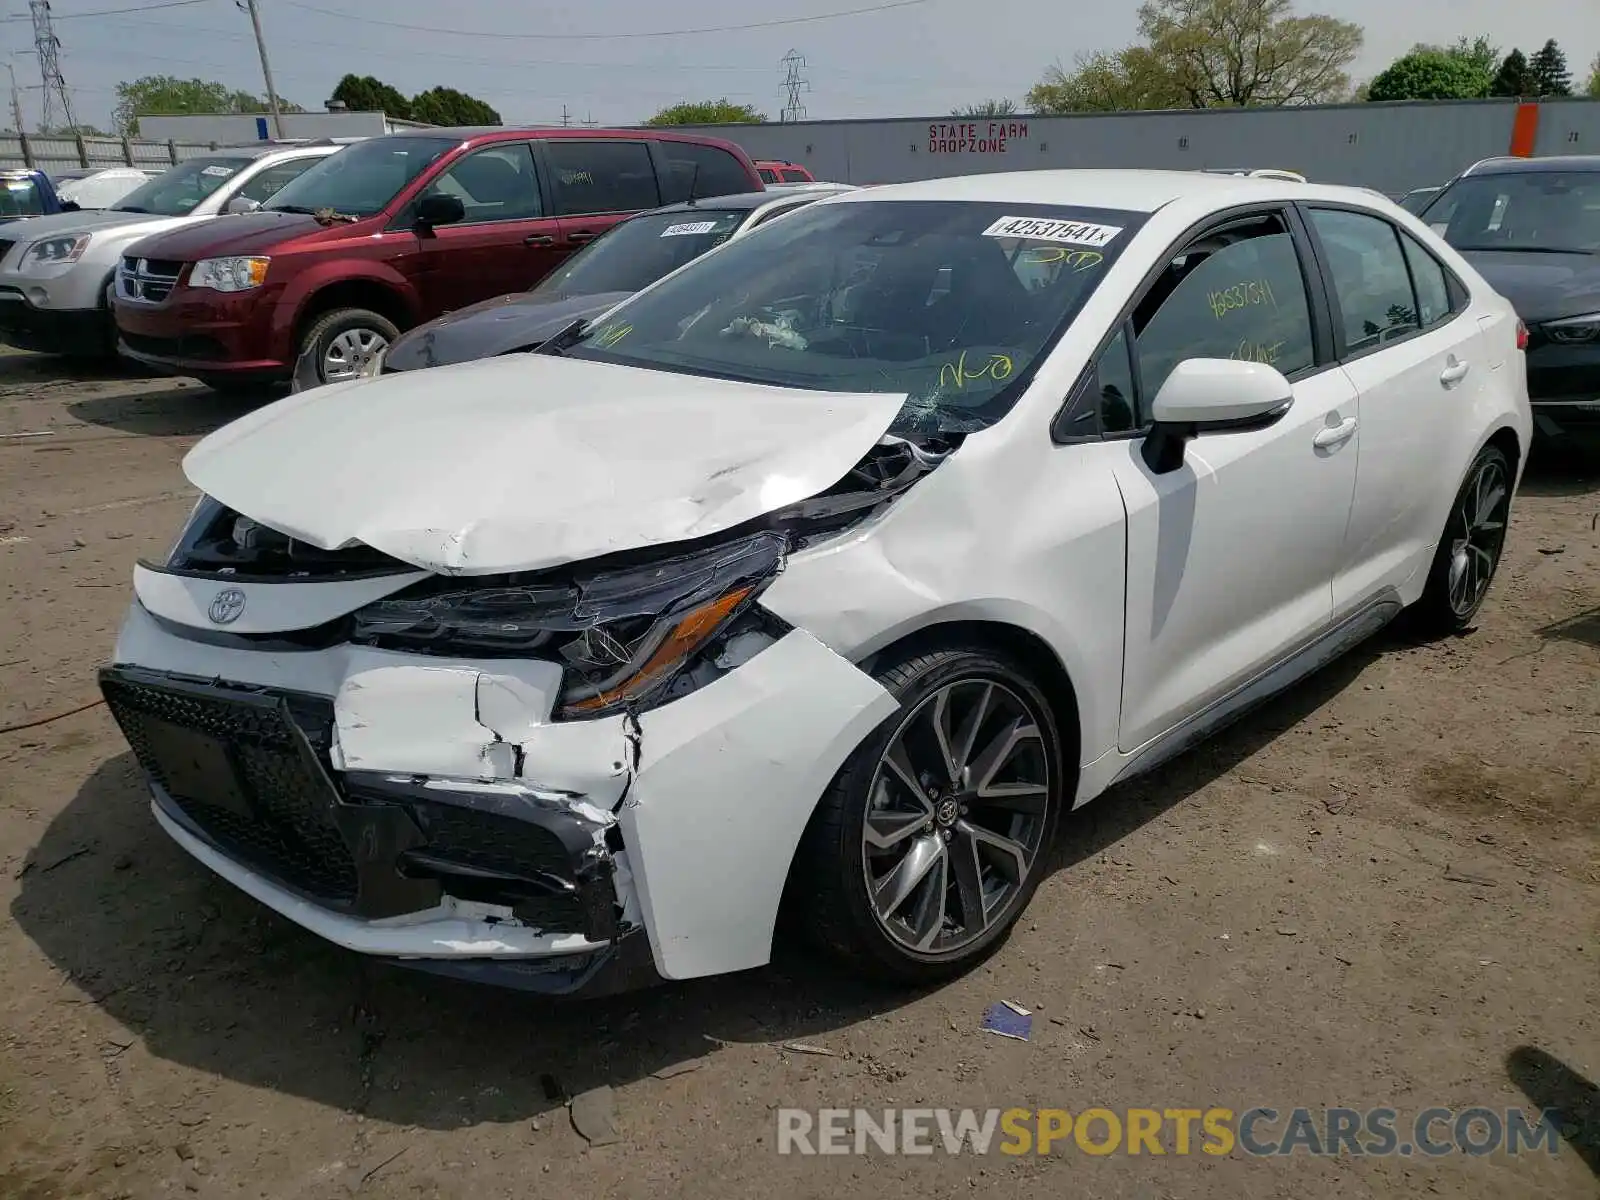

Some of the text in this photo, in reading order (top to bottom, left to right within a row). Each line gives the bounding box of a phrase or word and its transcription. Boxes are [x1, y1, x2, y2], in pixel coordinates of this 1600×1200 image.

[929, 123, 1028, 138] STATE FARM
[929, 139, 1007, 152] DROPZONE
